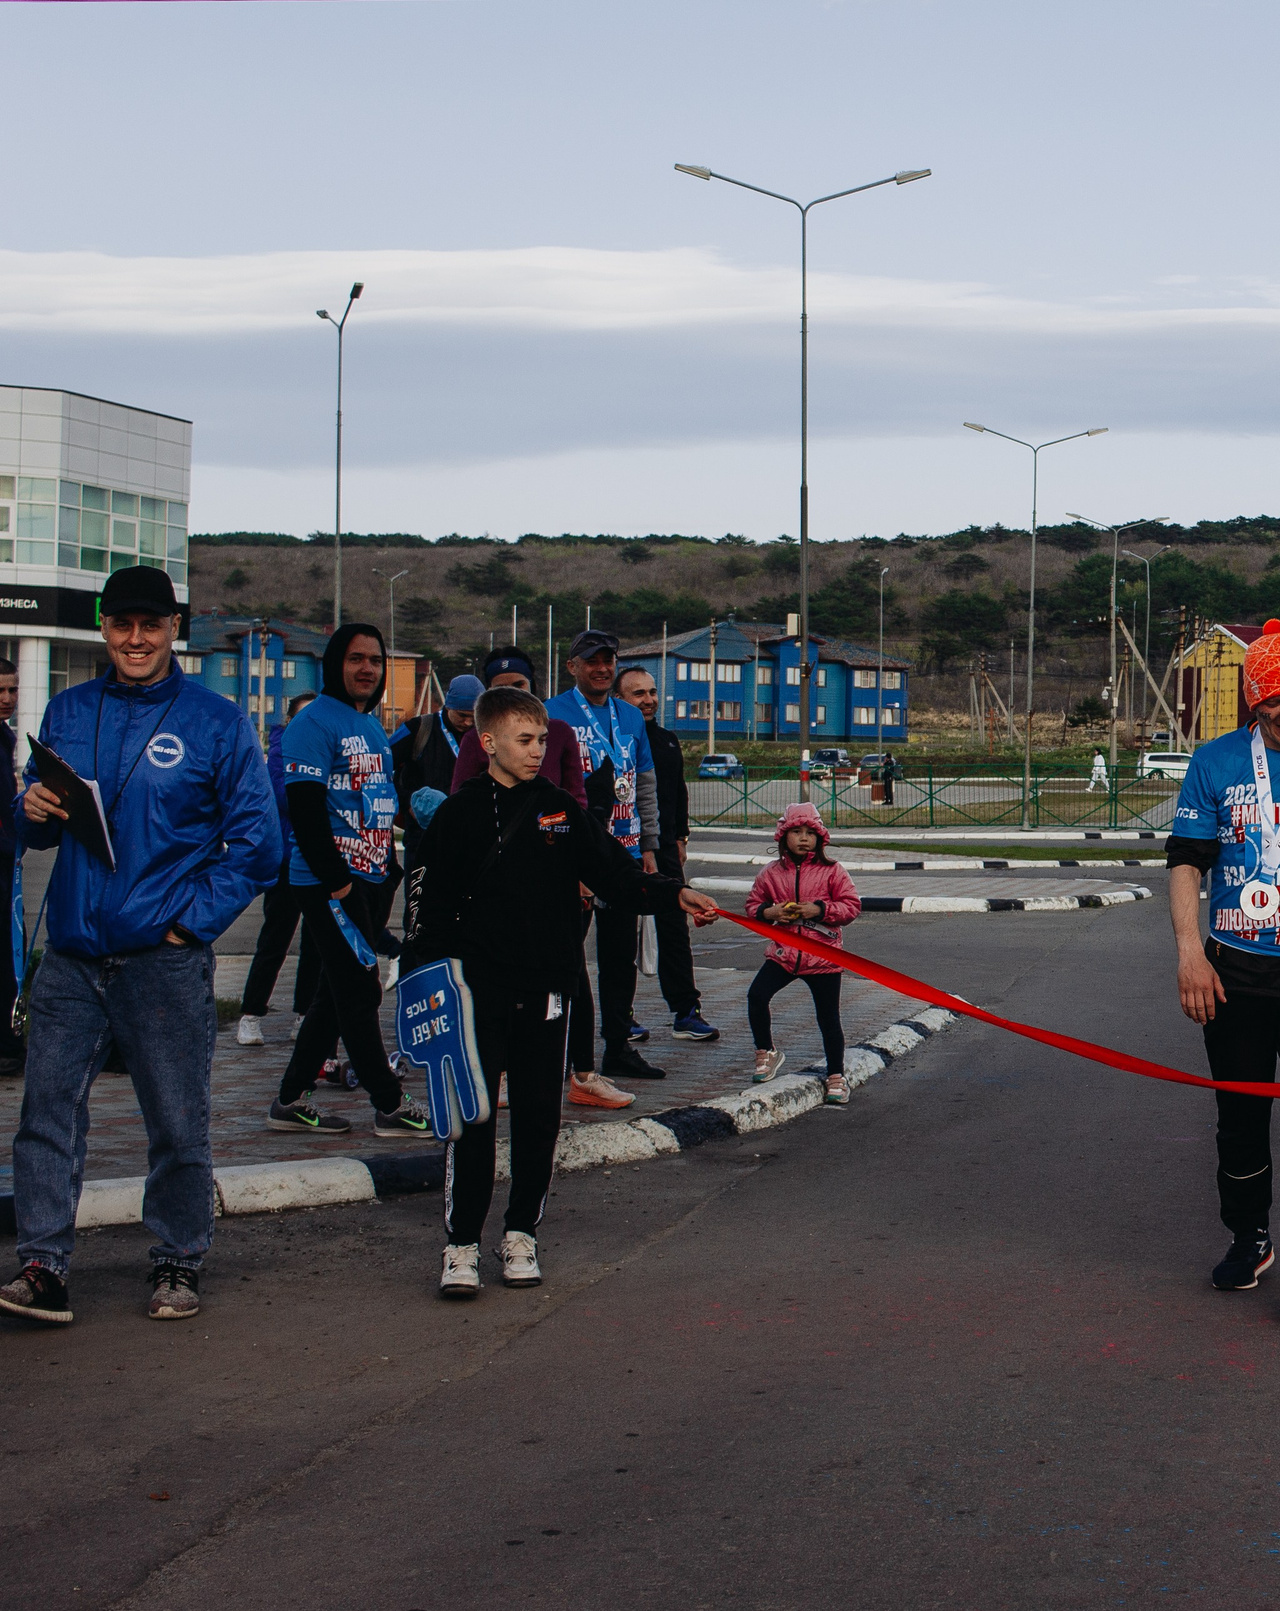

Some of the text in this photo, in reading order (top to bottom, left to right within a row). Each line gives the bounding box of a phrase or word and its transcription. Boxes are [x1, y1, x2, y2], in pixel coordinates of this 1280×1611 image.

[341, 734, 370, 757] 2024
[298, 764, 322, 777] ПСБ
[1256, 755, 1264, 770] ПСБ
[1224, 783, 1259, 807] 202
[1175, 807, 1199, 820] ПСБ
[405, 998, 428, 1019] ПСБ
[411, 1014, 450, 1046] ЗА БЕГ
